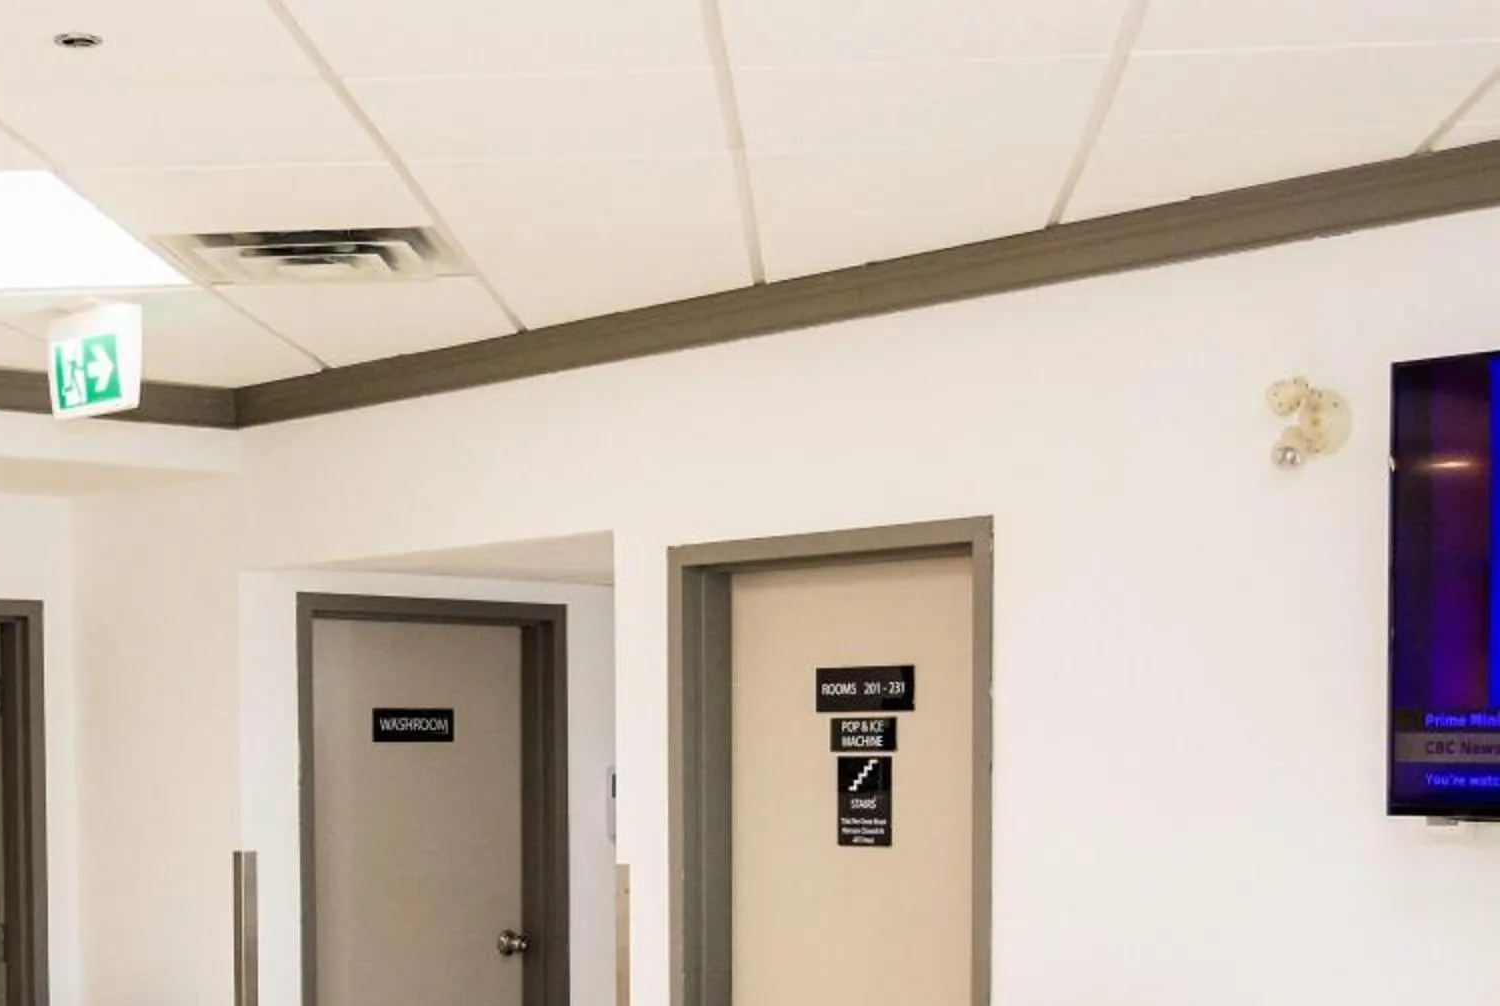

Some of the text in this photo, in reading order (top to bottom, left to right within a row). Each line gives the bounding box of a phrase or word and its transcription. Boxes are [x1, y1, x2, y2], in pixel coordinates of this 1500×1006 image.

[821, 683, 857, 696] ROOMS
[863, 682, 881, 695] 201
[888, 681, 906, 695] 231
[379, 717, 449, 732] WASHROOM
[841, 720, 861, 733] POP
[869, 720, 885, 732] ICE
[1424, 713, 1467, 727] Prime
[841, 735, 884, 747] MACHINE
[1425, 741, 1455, 755] CBC
[1425, 774, 1466, 786] You're
[851, 798, 878, 809] STAIRS
